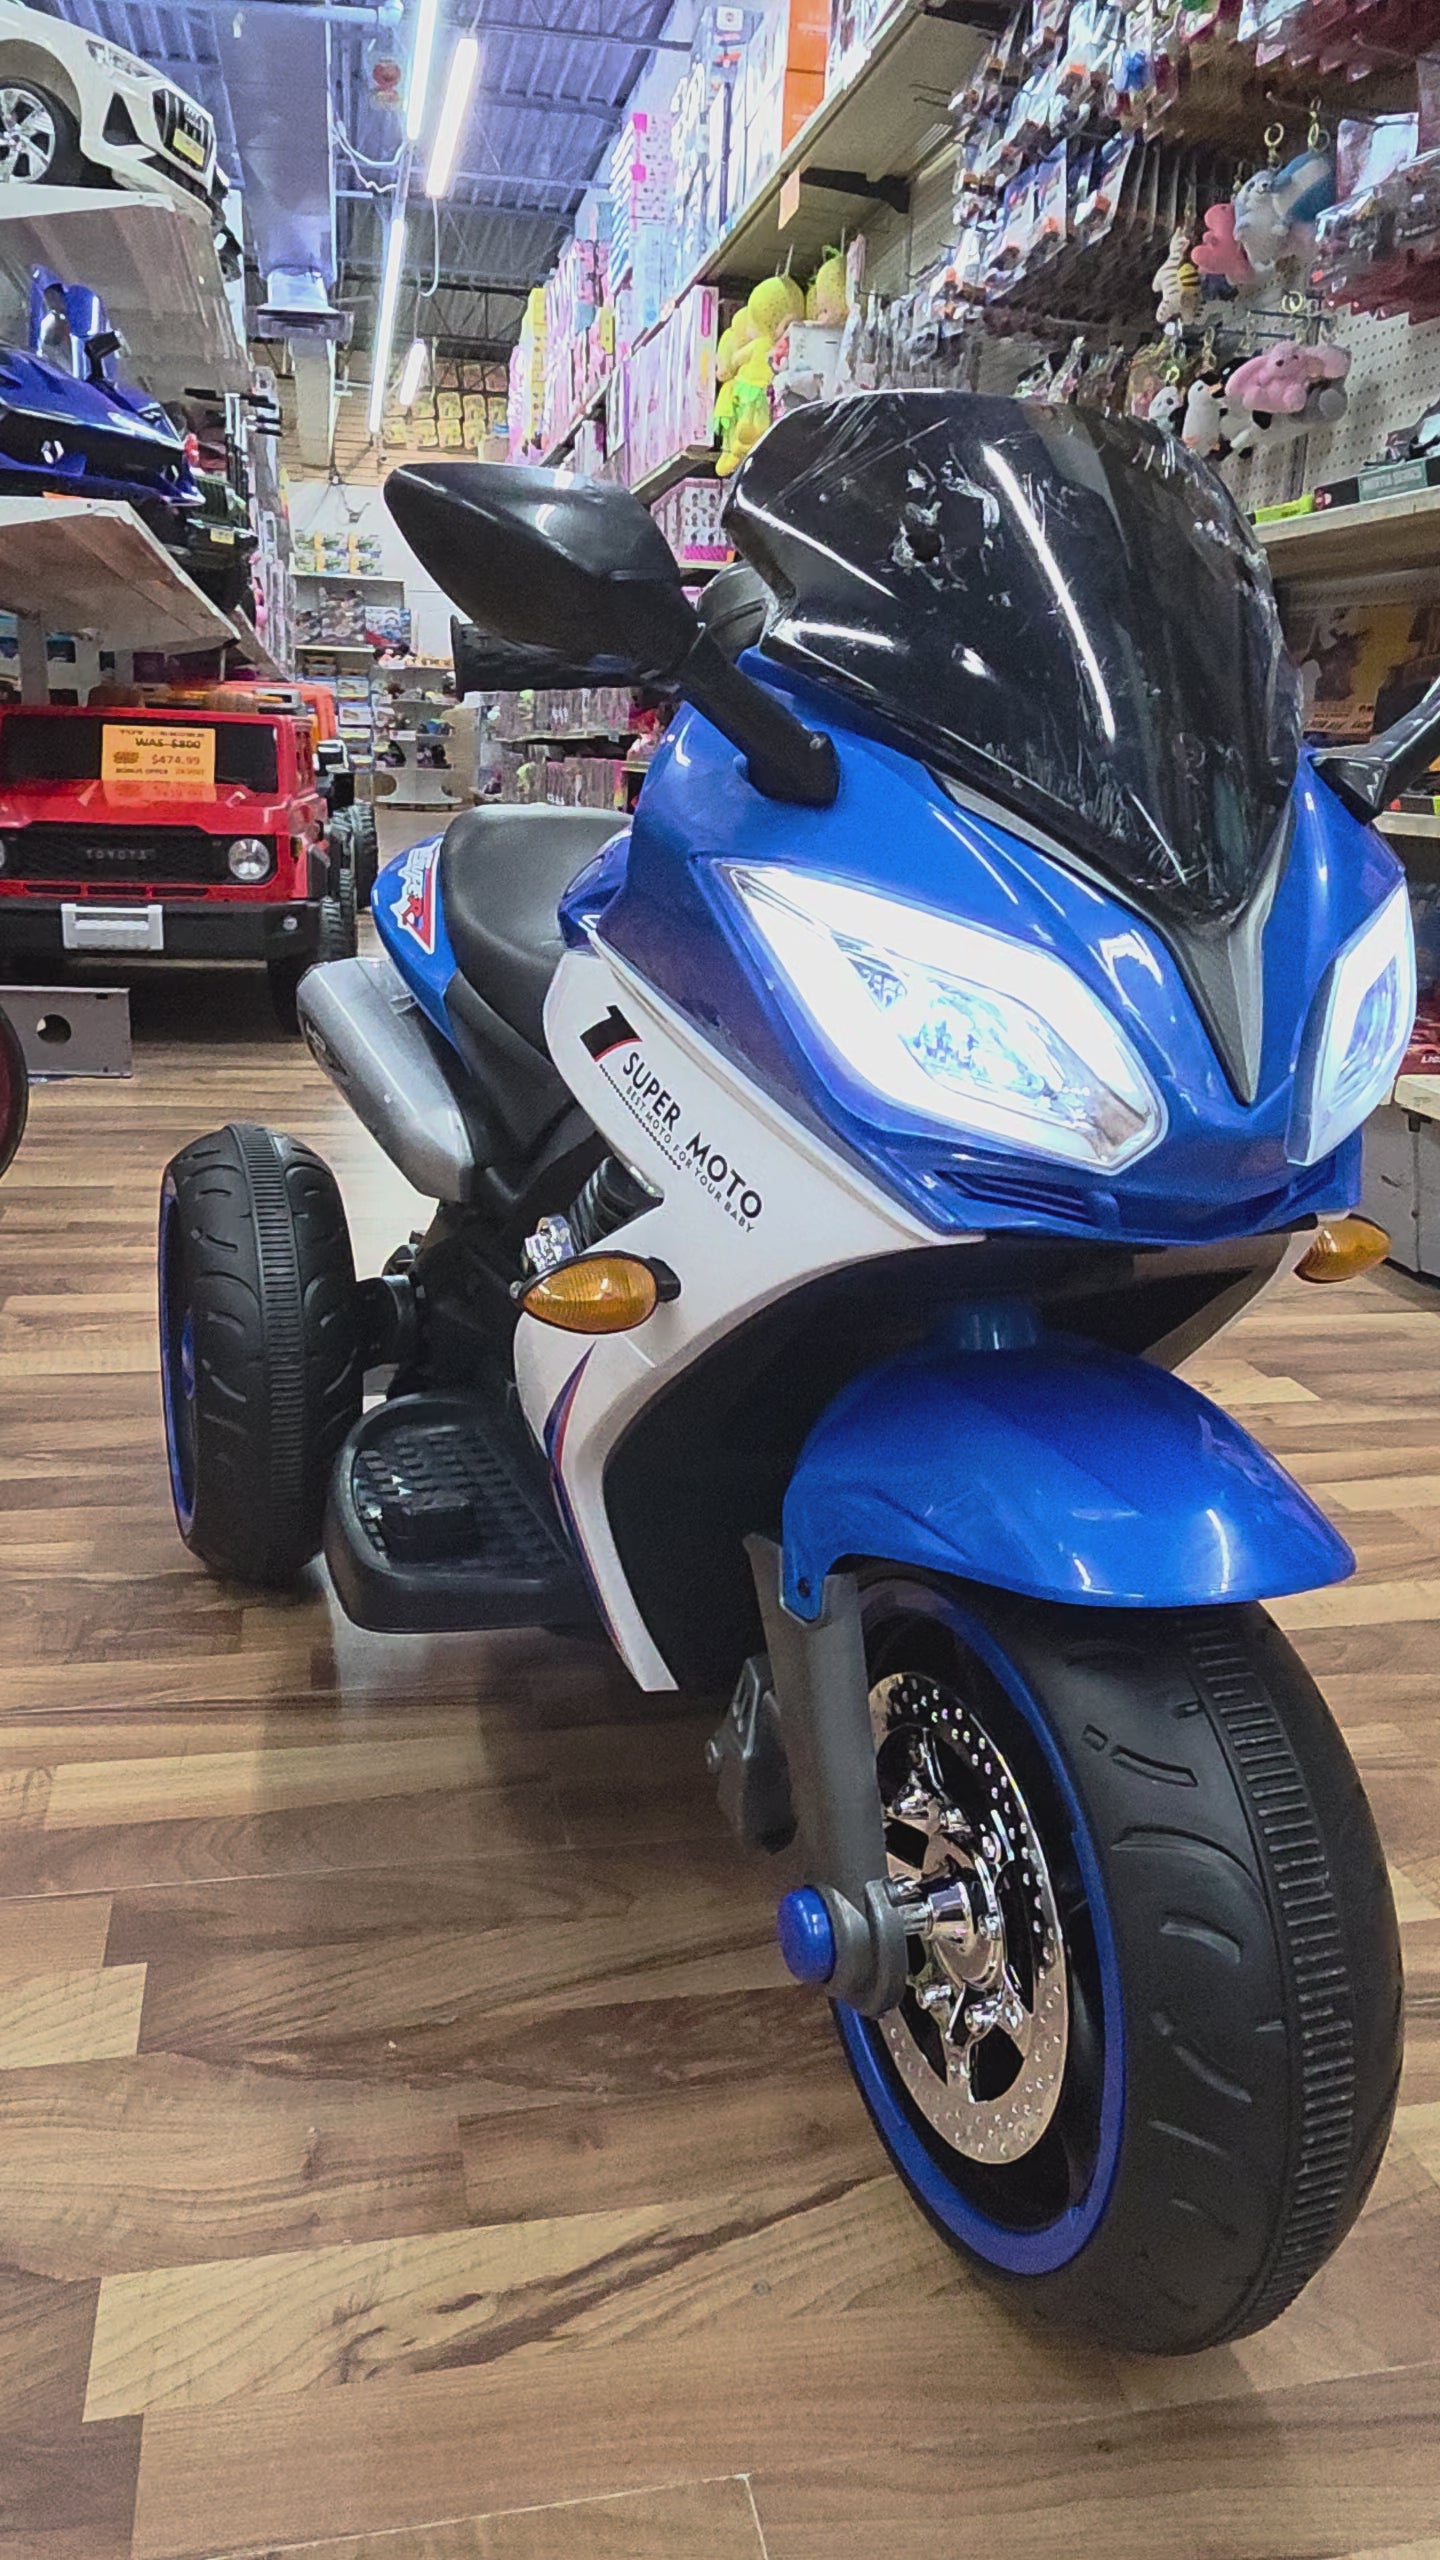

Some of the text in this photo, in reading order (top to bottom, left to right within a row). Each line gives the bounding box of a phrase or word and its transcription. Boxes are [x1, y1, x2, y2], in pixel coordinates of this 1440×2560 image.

[135, 737, 164, 747] WAS
[622, 1051, 762, 1219] SUPER MOTO
[626, 1085, 756, 1234] BEST MOTO FOR YOUR BABY
